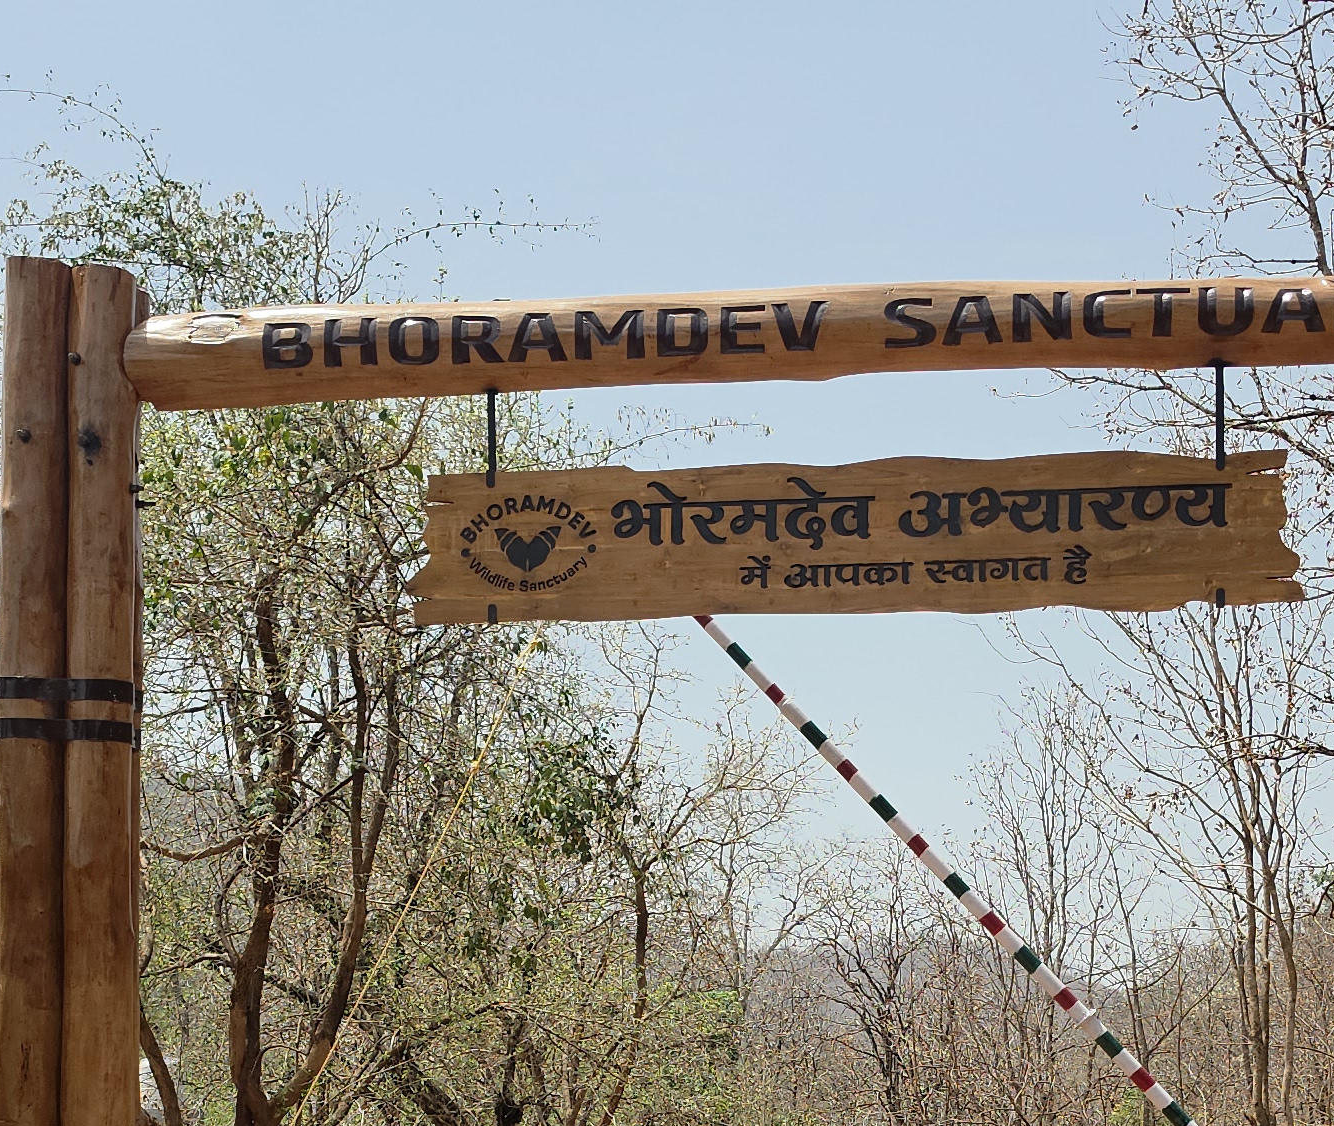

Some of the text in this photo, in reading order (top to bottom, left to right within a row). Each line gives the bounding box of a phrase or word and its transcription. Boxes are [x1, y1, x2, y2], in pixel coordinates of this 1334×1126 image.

[262, 300, 831, 370] BHORAMDEV
[460, 495, 597, 545] BHORAMDEV
[610, 476, 1233, 550] भोरमदेव अभ्यारण्य
[469, 556, 588, 593] Wildlife Sanctuary
[739, 544, 1092, 589] में आपका स्वागत है
